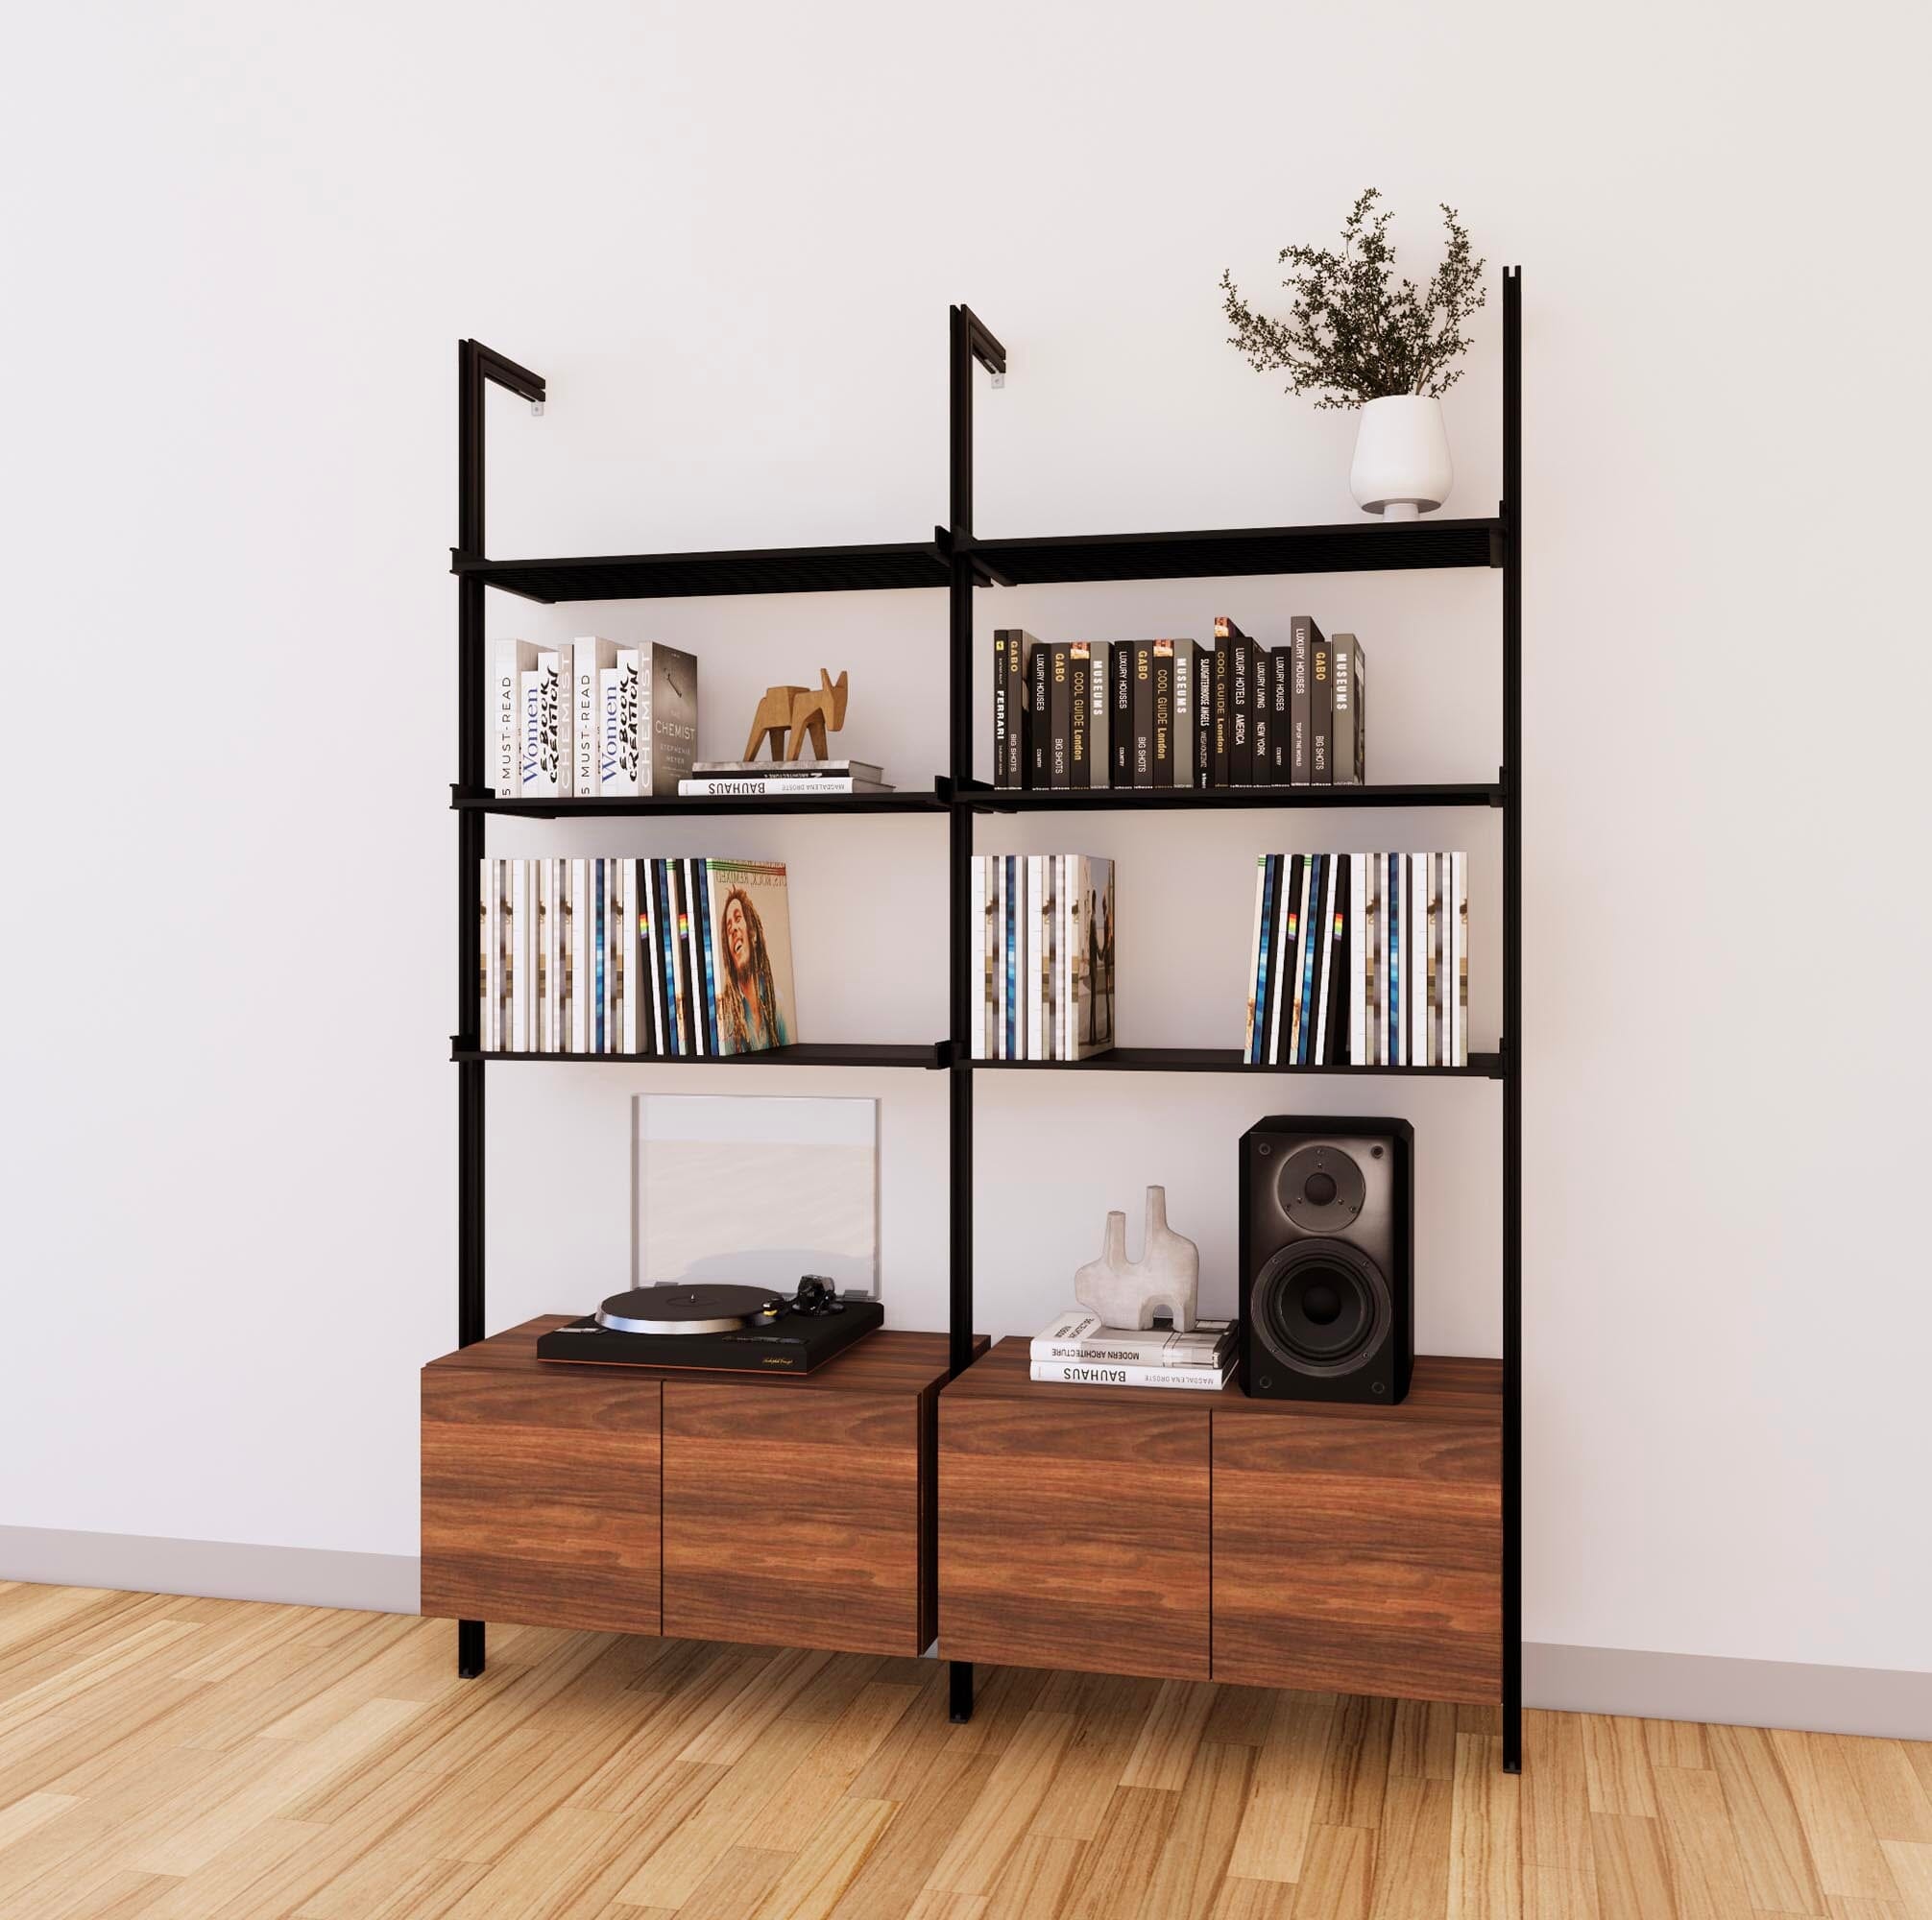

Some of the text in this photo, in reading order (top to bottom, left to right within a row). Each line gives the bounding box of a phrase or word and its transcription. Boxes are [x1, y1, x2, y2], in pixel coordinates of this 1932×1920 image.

[1036, 654, 1045, 711] LUXURY HOUSES
[1055, 653, 1065, 683] GABO
[1093, 660, 1103, 715] MUSEUMS
[1138, 650, 1147, 680] GABO
[1177, 658, 1187, 714] MUSEUMS
[1217, 651, 1225, 680] COOL
[1236, 647, 1244, 705] LUXURY HOTELS
[1257, 661, 1266, 708] LUXURY LIVING
[1276, 657, 1285, 711] LUXURY HOUSES
[1296, 629, 1305, 694] LUXURY HOUSES
[1316, 652, 1326, 681] GABO
[1337, 653, 1347, 710] MUSEUMS
[539, 678, 549, 772] E-BOOK
[547, 664, 560, 783] CREATION
[561, 653, 569, 789] CHEMIST
[619, 676, 629, 770] E-BOOK
[627, 662, 639, 782] CREATION
[641, 652, 650, 788] CHEMIST
[1075, 671, 1084, 760] COOL GUIDE London
[1157, 669, 1167, 759] COOL GUIDE London
[1217, 683, 1225, 714] GUIDE
[501, 677, 511, 779] MUST-READ
[522, 688, 538, 784] Women
[581, 675, 591, 795] 5 MUST-READ
[602, 685, 617, 783] Women
[655, 720, 695, 740] CHEMIST
[1236, 713, 1244, 746] AMERICA
[1257, 722, 1266, 756] NEW YORK
[1316, 735, 1324, 770] BIG SHOTS
[708, 781, 765, 795] BAUHAUS
[1051, 1348, 1140, 1360] MODERN ARCHITECTURE
[1064, 1367, 1126, 1382] BAUHAUS
